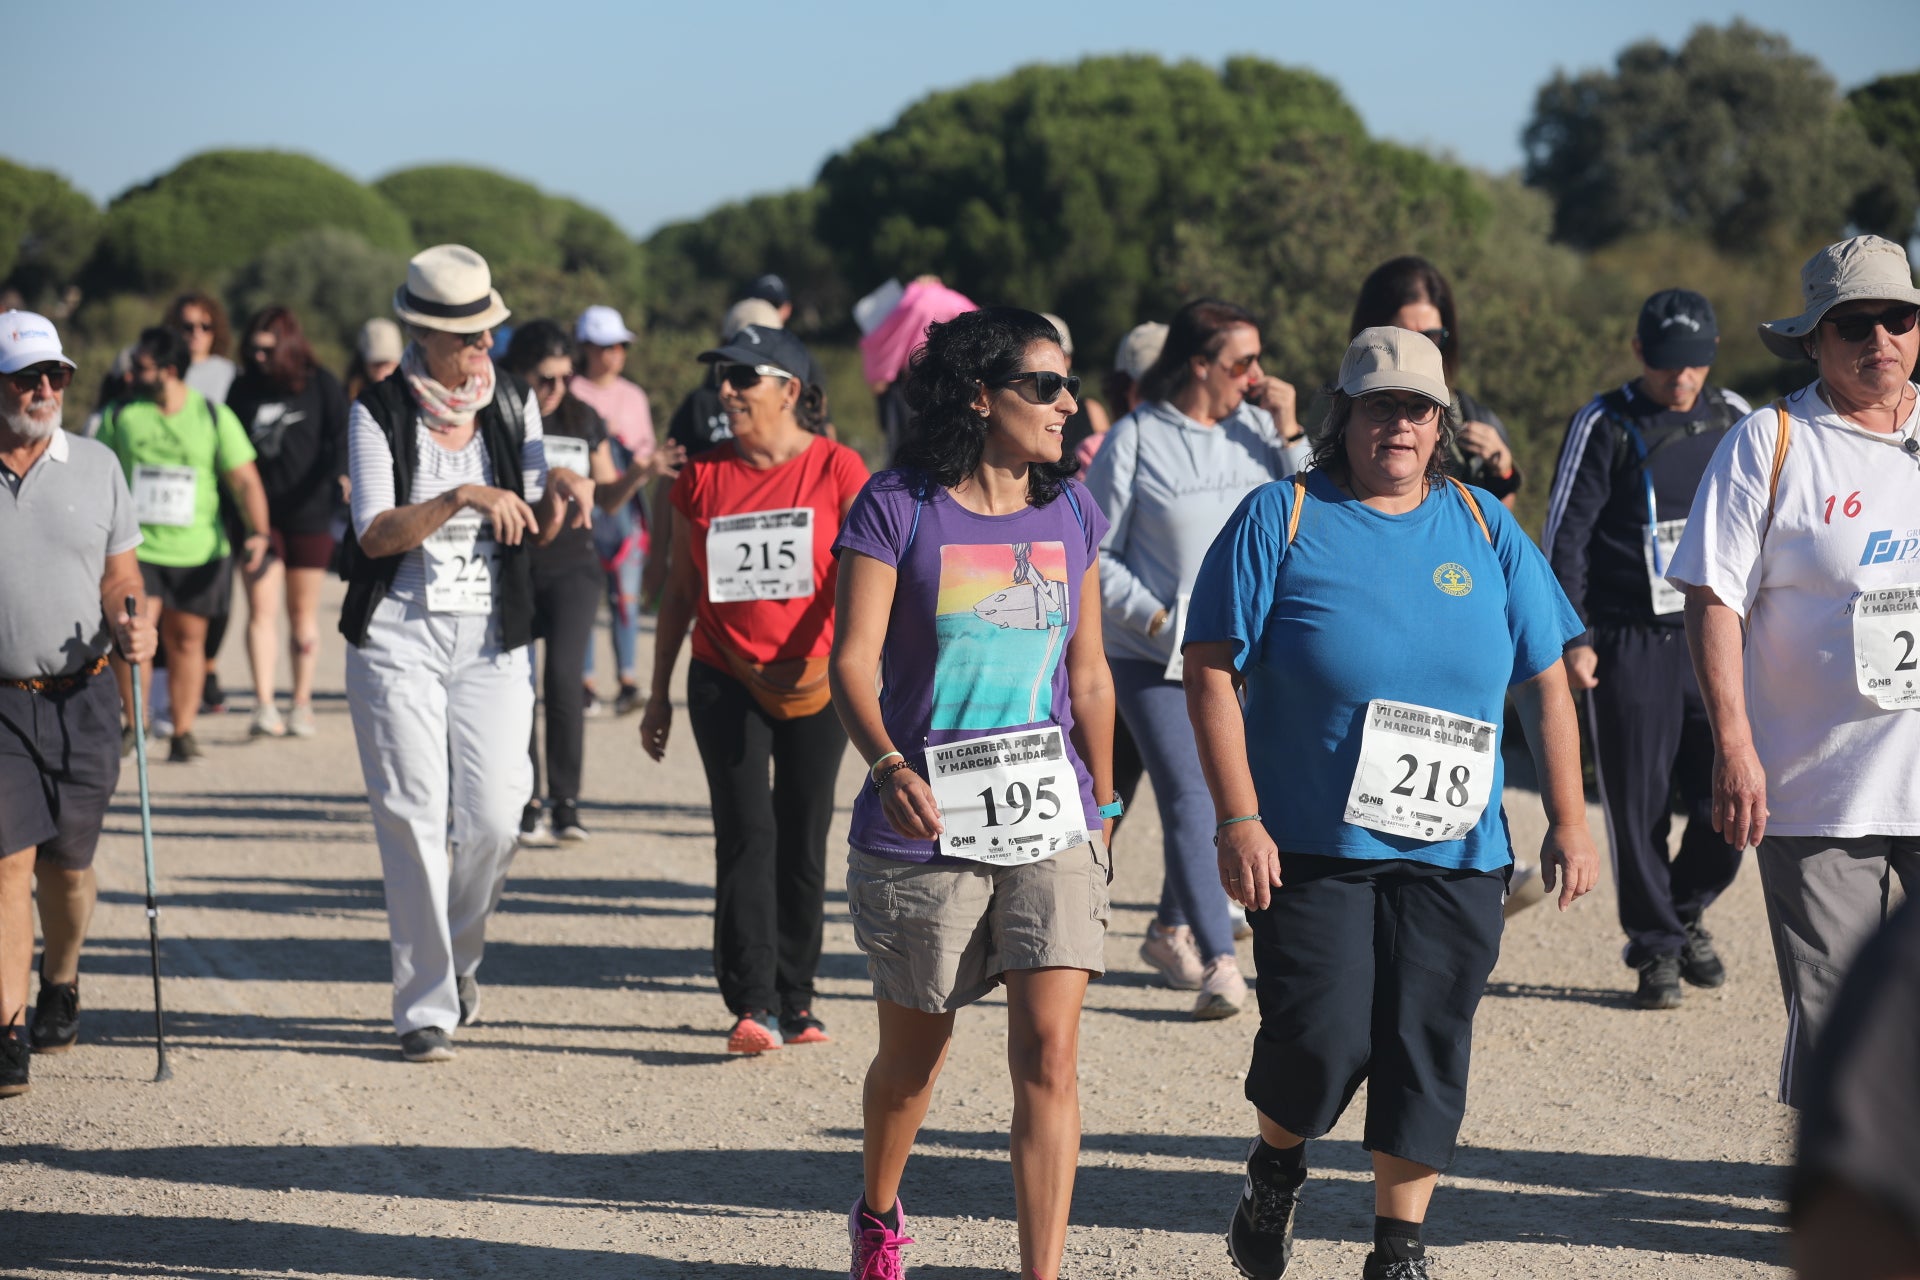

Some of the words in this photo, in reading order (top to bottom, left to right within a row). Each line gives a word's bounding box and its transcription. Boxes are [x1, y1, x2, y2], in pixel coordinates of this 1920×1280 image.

[1824, 490, 1862, 525] 16
[736, 540, 796, 573] 215
[1862, 606, 1869, 614] Y
[1872, 601, 1919, 613] MARCHA
[1863, 593, 1876, 602] VII
[1893, 630, 1918, 671] 2
[1878, 678, 1891, 686] NB
[1376, 705, 1391, 716] VII
[1393, 709, 1445, 727] CARRERA
[1373, 718, 1382, 727] Y
[1383, 720, 1431, 736] MARCHA
[936, 752, 953, 761] VII
[956, 739, 1012, 758] CARRERA
[939, 765, 946, 774] Y
[950, 756, 1000, 772] MARCHA
[1390, 753, 1471, 808] 218
[976, 776, 1061, 828] 195
[1369, 796, 1384, 806] NB
[962, 835, 976, 844] NB
